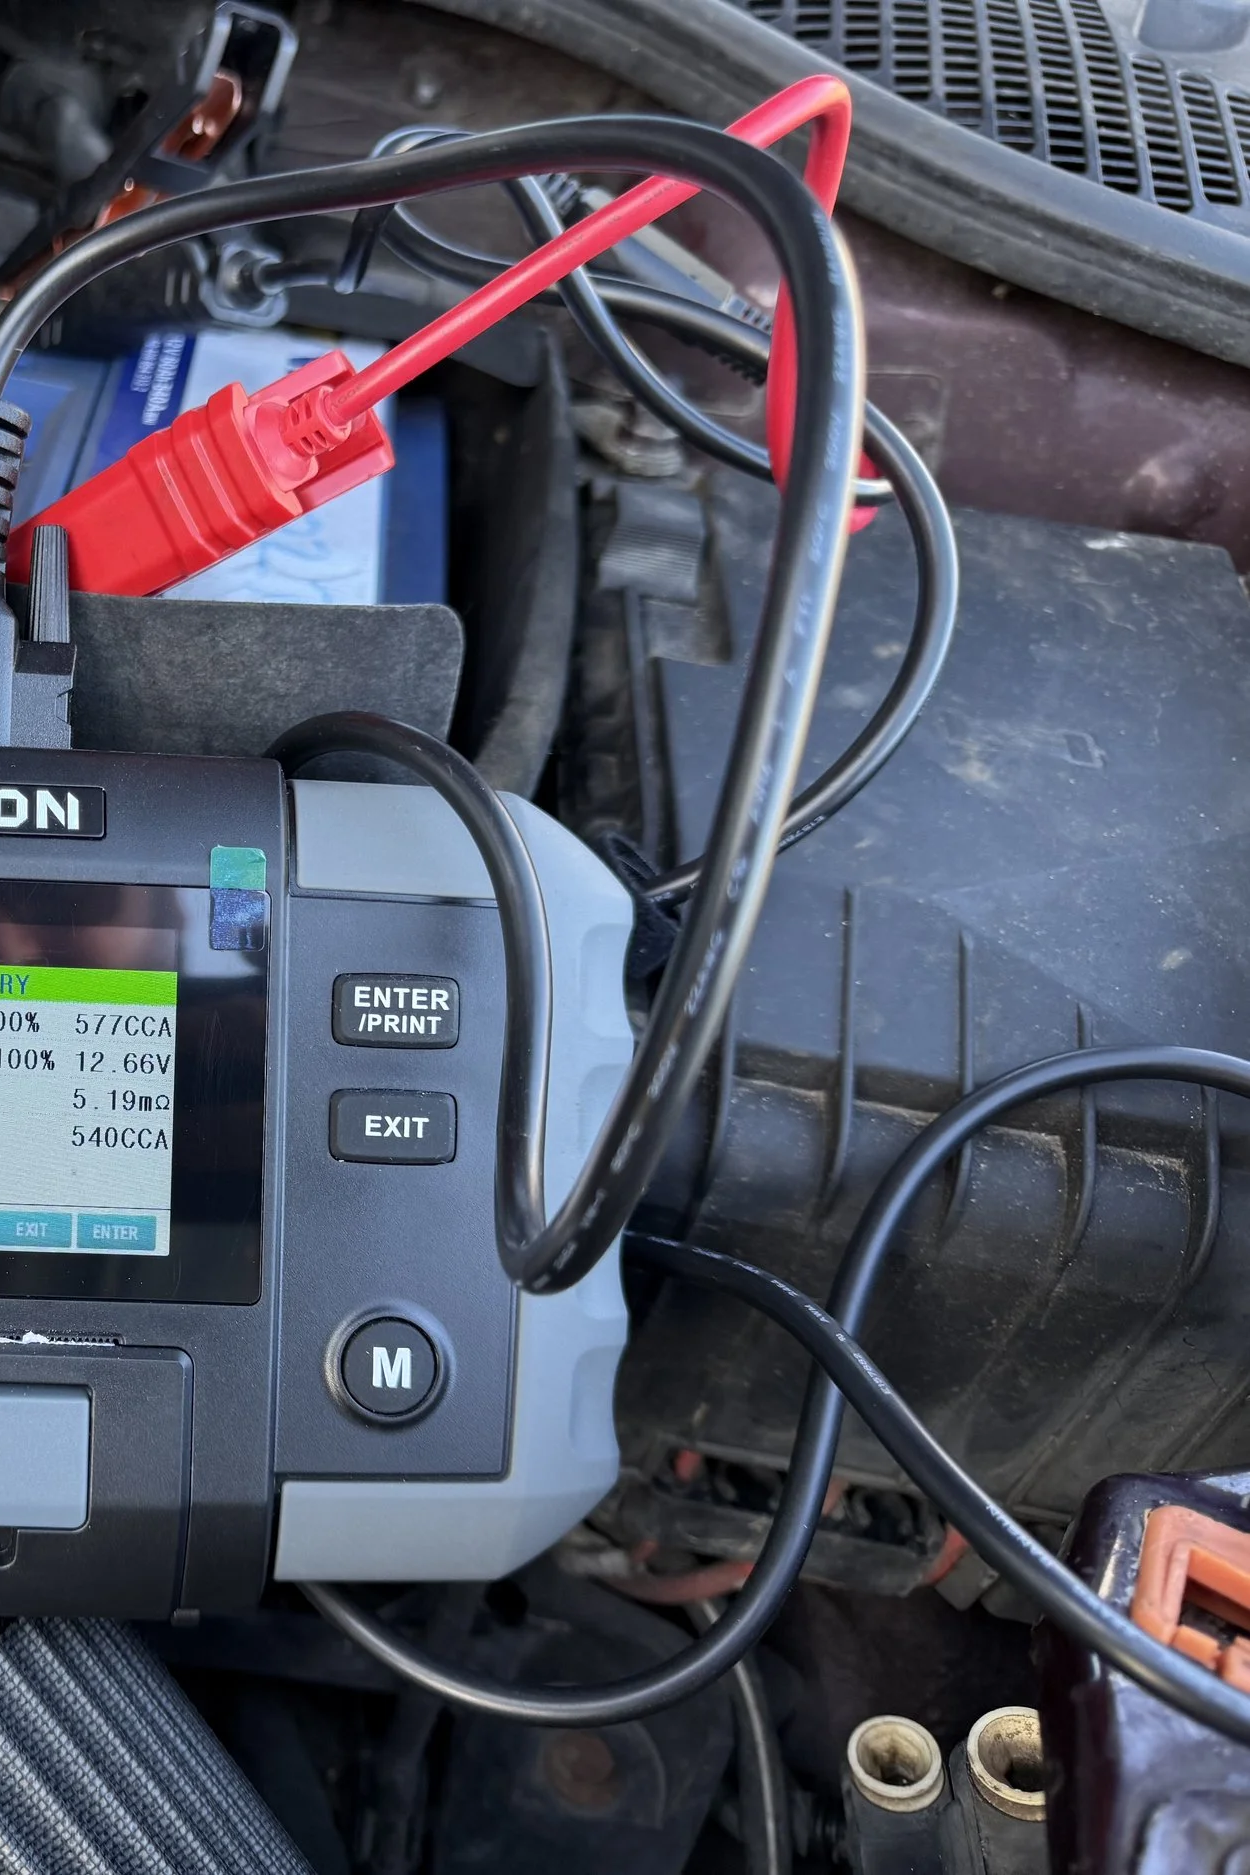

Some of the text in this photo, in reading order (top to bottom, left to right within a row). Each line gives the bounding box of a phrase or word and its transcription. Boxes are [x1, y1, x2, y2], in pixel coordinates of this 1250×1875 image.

[829, 306, 848, 383] 22AWG
[822, 410, 843, 472] 300V
[684, 930, 723, 1018] 22AWG
[354, 985, 450, 1011] ENTER
[75, 1013, 172, 1038] 577CCA
[358, 1013, 442, 1035] /PRINT
[75, 1051, 172, 1075] 12.66V
[647, 1042, 679, 1099] 300V
[72, 1088, 171, 1112] 5.19mΩ
[70, 1126, 169, 1150] 540CCA
[365, 1115, 430, 1139] EXIT
[15, 1222, 139, 1241] EXIT ENTER
[769, 1277, 800, 1297] 2464
[803, 1302, 830, 1323] AWM
[372, 1346, 412, 1389] M
[851, 1350, 892, 1394] E157882
